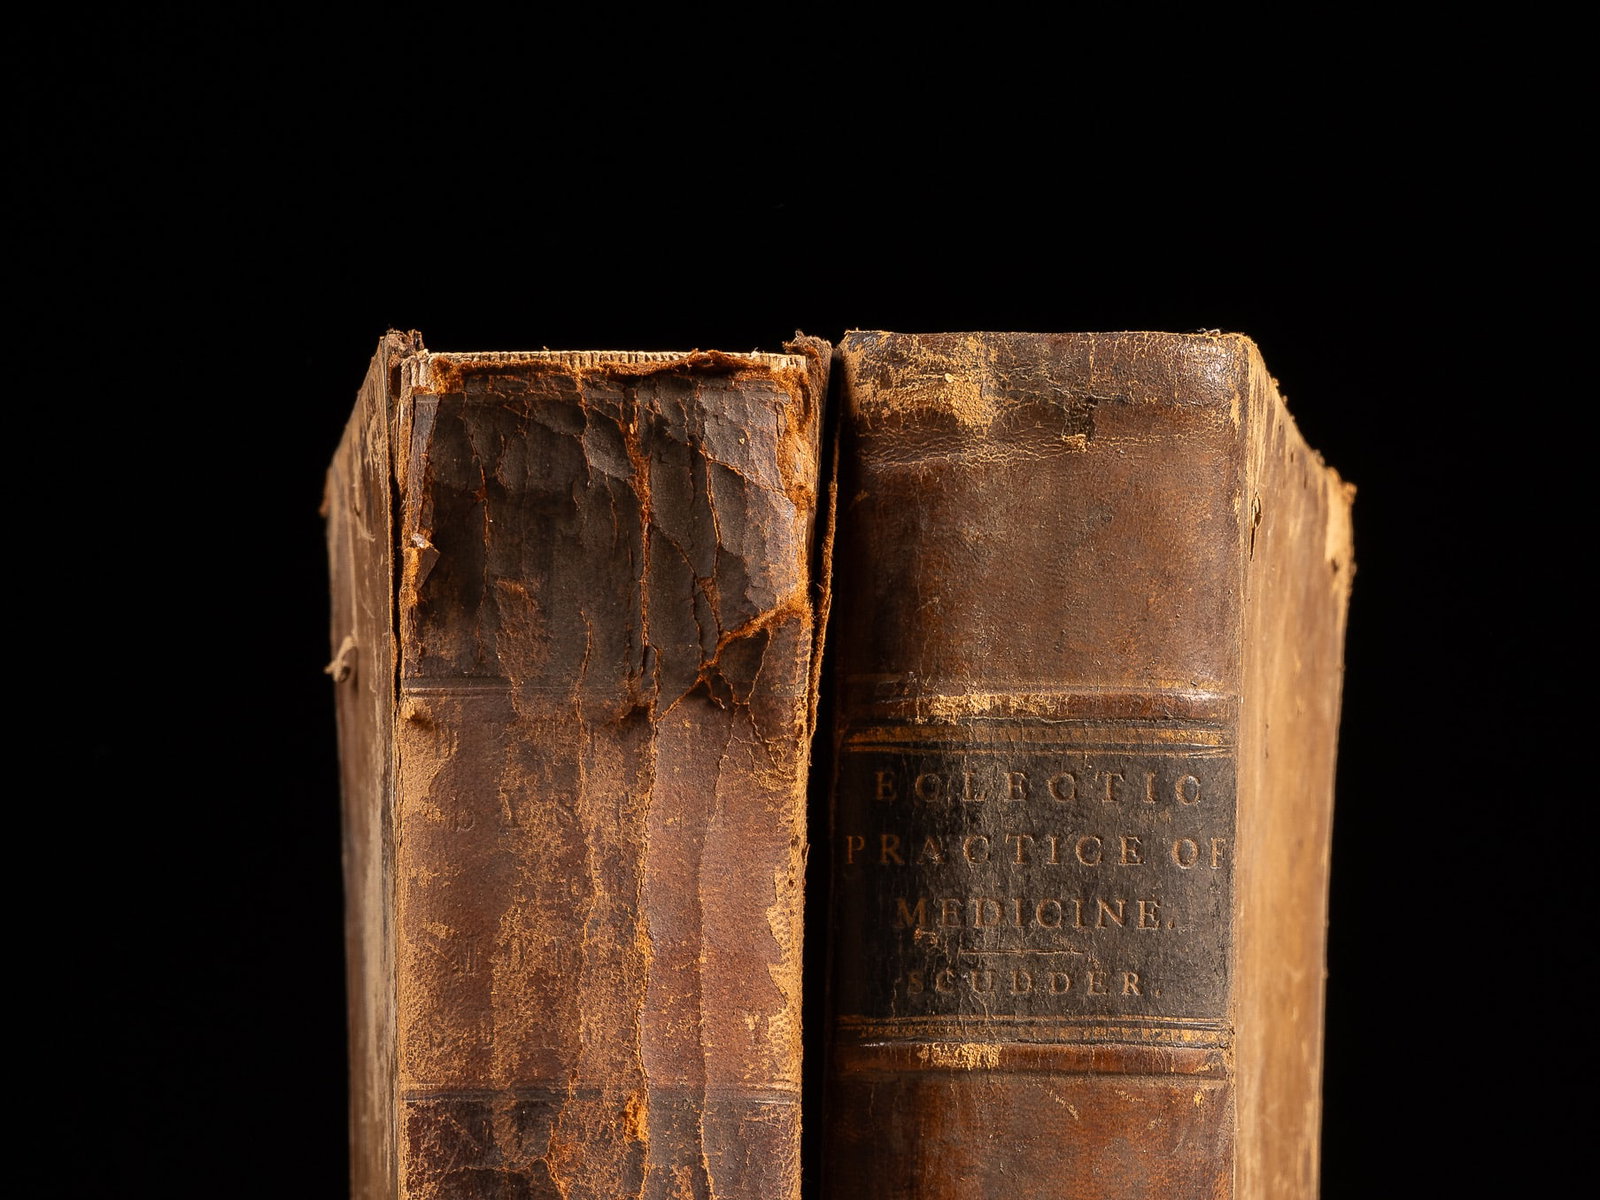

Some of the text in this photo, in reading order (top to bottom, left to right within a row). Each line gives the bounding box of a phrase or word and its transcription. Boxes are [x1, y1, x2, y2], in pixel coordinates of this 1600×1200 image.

[874, 769, 1202, 805] ECLECTIC
[845, 834, 1227, 870] PRACTICE OF
